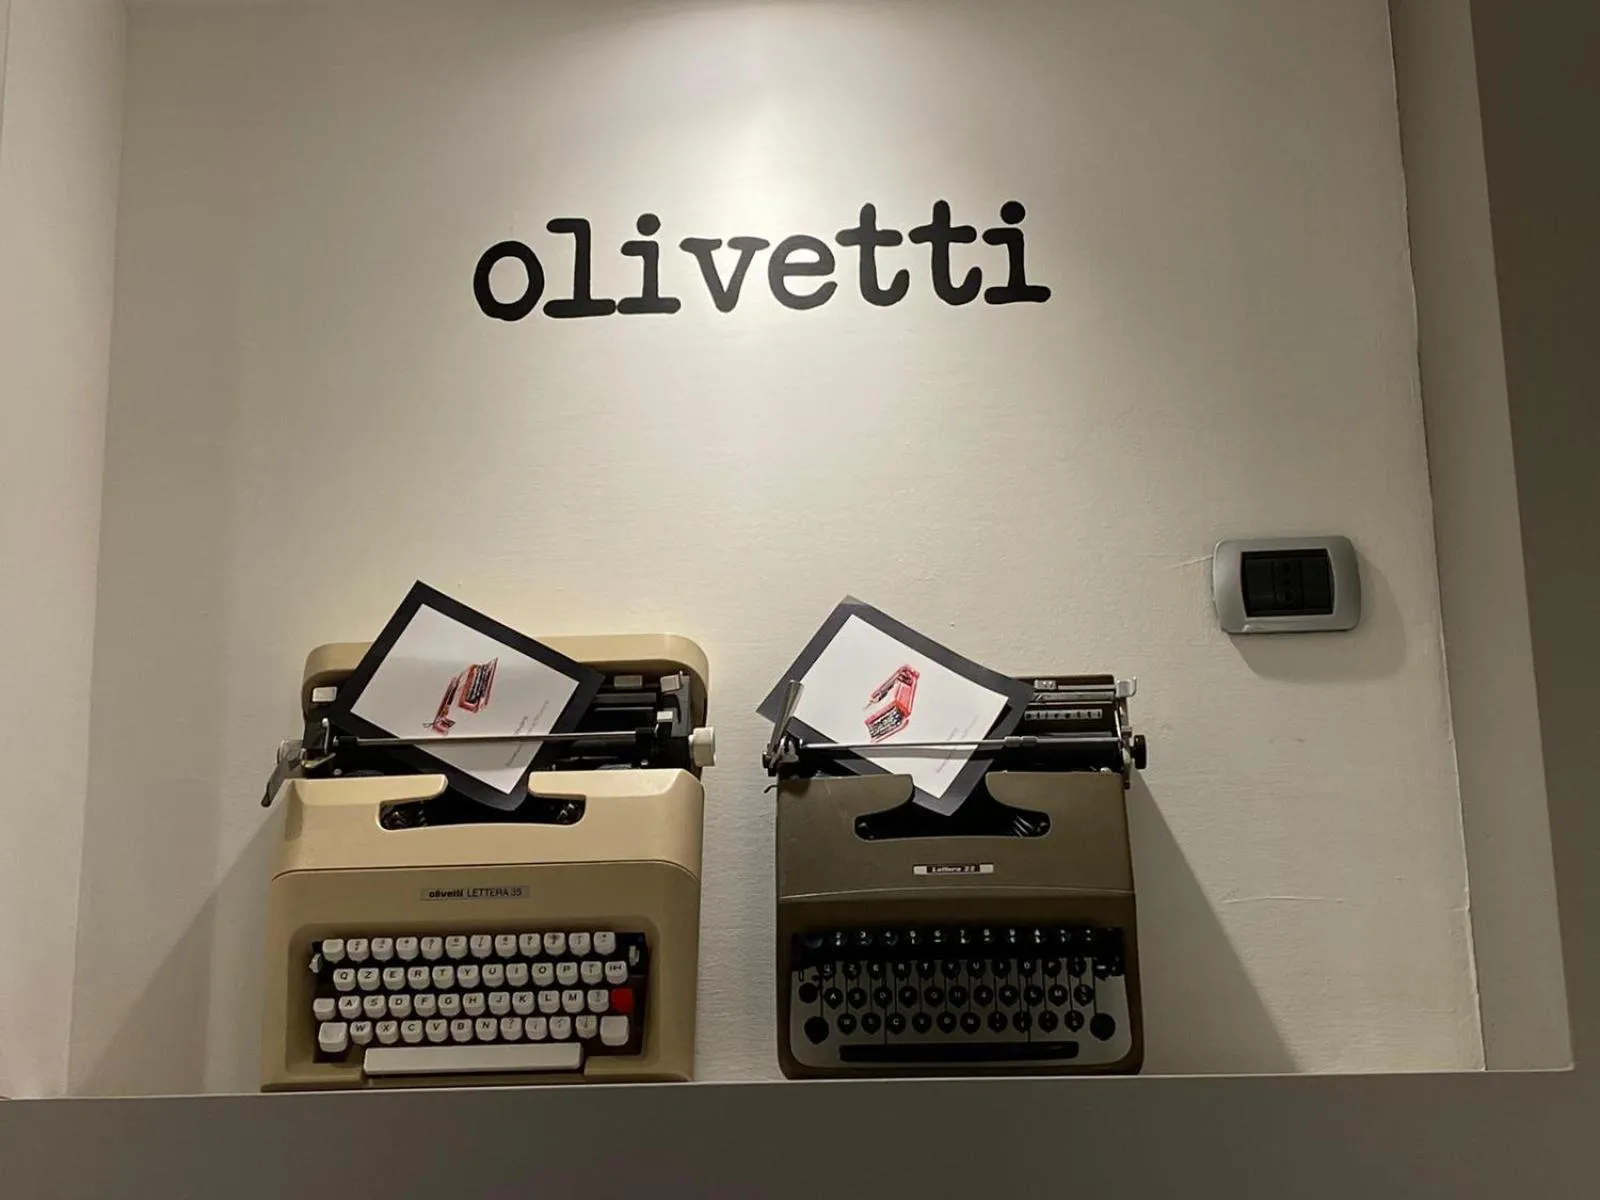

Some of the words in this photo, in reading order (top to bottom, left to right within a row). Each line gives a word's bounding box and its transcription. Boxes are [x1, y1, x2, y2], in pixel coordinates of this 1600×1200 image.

[473, 200, 1051, 321] olivetti
[428, 888, 464, 898] olivetti
[466, 887, 509, 898] LETTERA
[510, 887, 523, 897] 35
